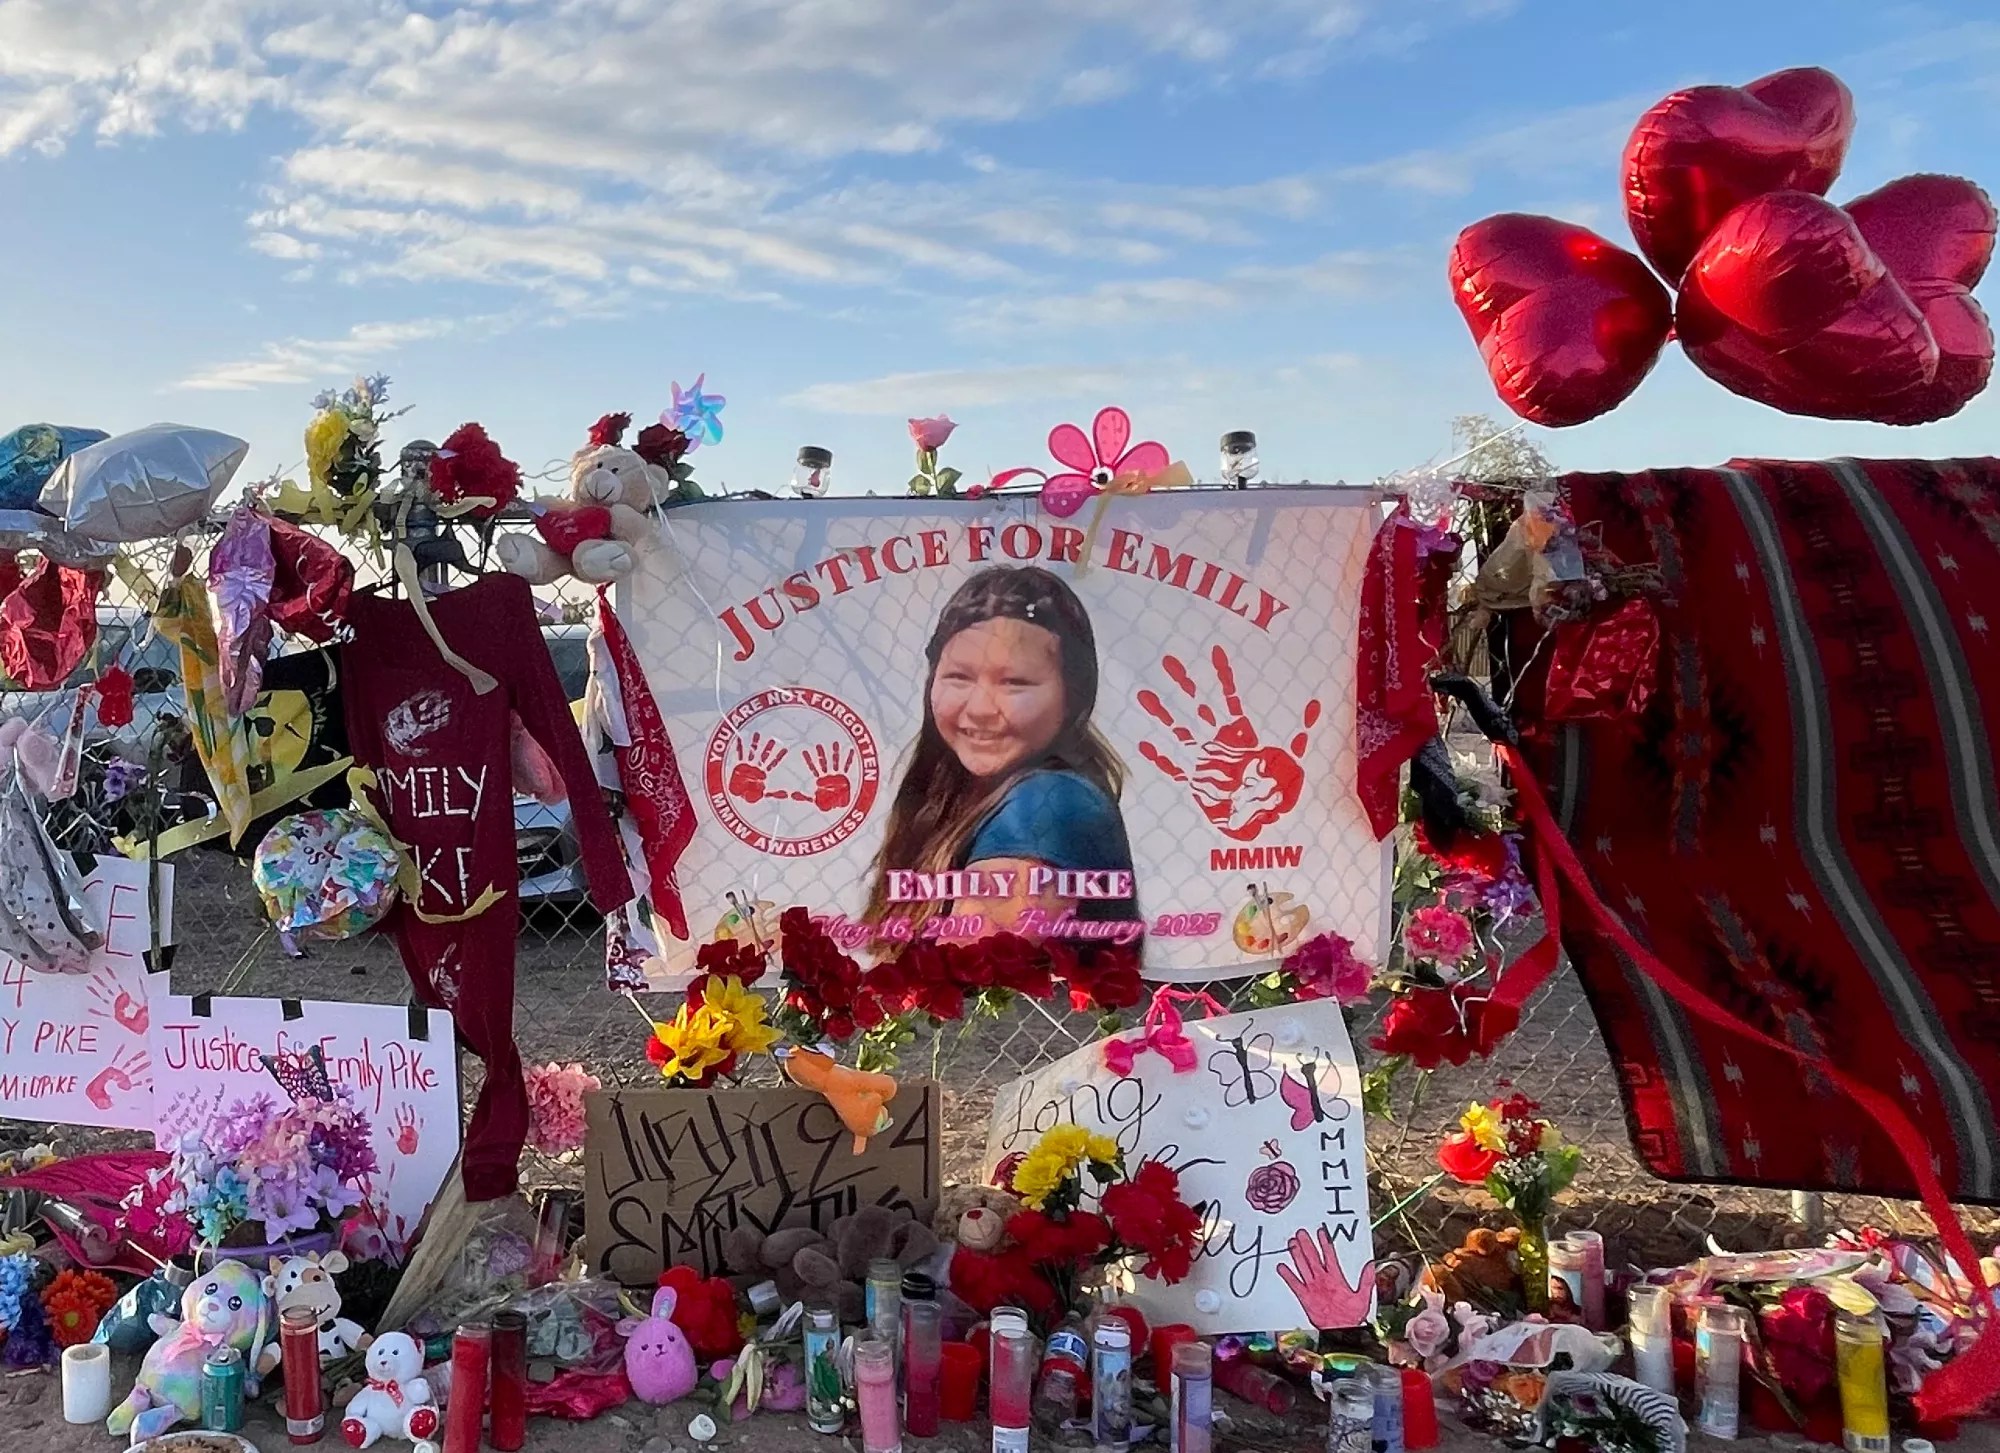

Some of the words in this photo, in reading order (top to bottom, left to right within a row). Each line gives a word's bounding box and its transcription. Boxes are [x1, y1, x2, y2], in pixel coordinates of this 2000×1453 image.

[718, 527, 950, 662] JUSTICE
[967, 523, 1086, 563] FOR
[1102, 528, 1290, 634] EMILY
[710, 726, 733, 764] YOU
[730, 699, 764, 728] ARE
[767, 690, 807, 706] NOT
[810, 693, 878, 782] FORGOTTEN
[711, 792, 752, 840] MMIW
[753, 808, 866, 856] AWARENESS
[1211, 845, 1303, 871] MMIW
[887, 869, 1015, 901] EMILY
[1029, 866, 1133, 899] PIKE
[809, 913, 872, 949] May
[921, 914, 983, 939] 2010
[1012, 907, 1147, 945] February
[1150, 912, 1222, 937] 2025
[162, 1025, 265, 1074] Justice
[319, 1036, 383, 1114] Emily
[889, 1086, 930, 1199] 4
[1002, 1077, 1163, 1156] Long
